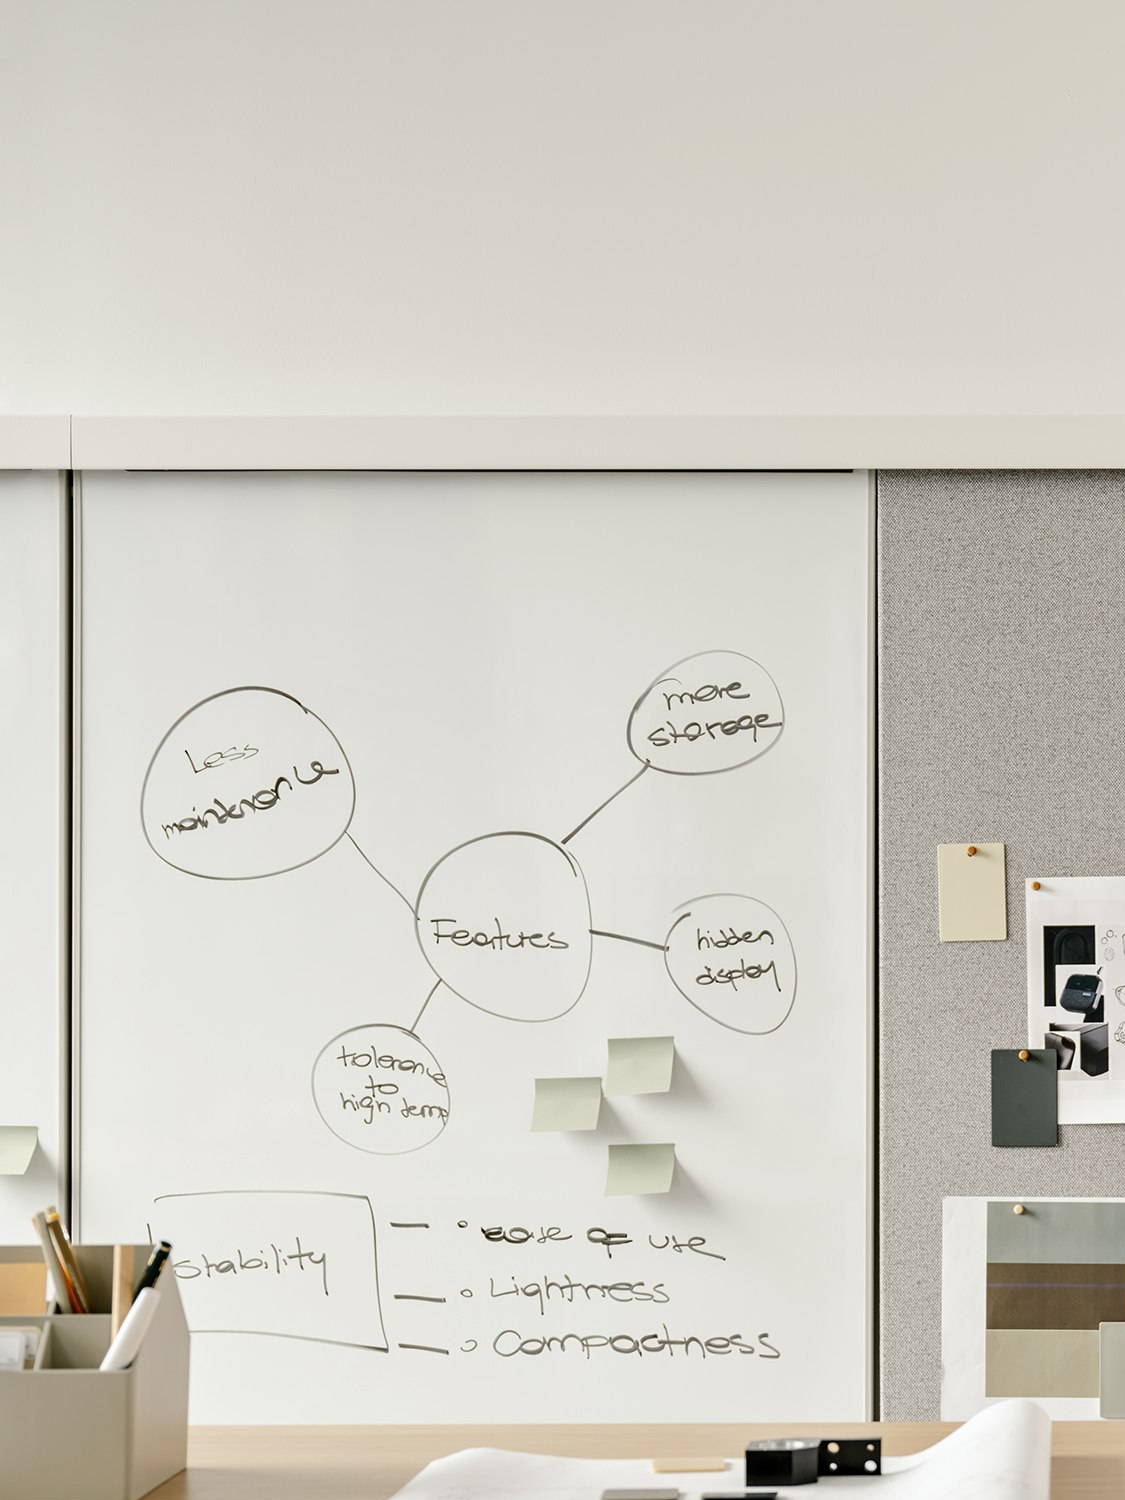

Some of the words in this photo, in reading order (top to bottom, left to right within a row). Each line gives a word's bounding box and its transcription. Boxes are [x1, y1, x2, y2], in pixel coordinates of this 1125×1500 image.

[662, 681, 751, 711] more
[647, 713, 783, 747] storage
[185, 744, 260, 774] Less
[430, 917, 570, 950] Features
[696, 927, 775, 951] hidden
[695, 958, 782, 992] display
[336, 1045, 448, 1088] tolerance
[364, 1074, 400, 1098] to
[401, 1097, 450, 1127] temp
[480, 1225, 573, 1244] ease
[586, 1226, 634, 1259] of
[648, 1232, 727, 1261] use
[172, 1235, 330, 1297] stability
[489, 1274, 671, 1316] Lightness
[492, 1322, 781, 1360] Compactness
